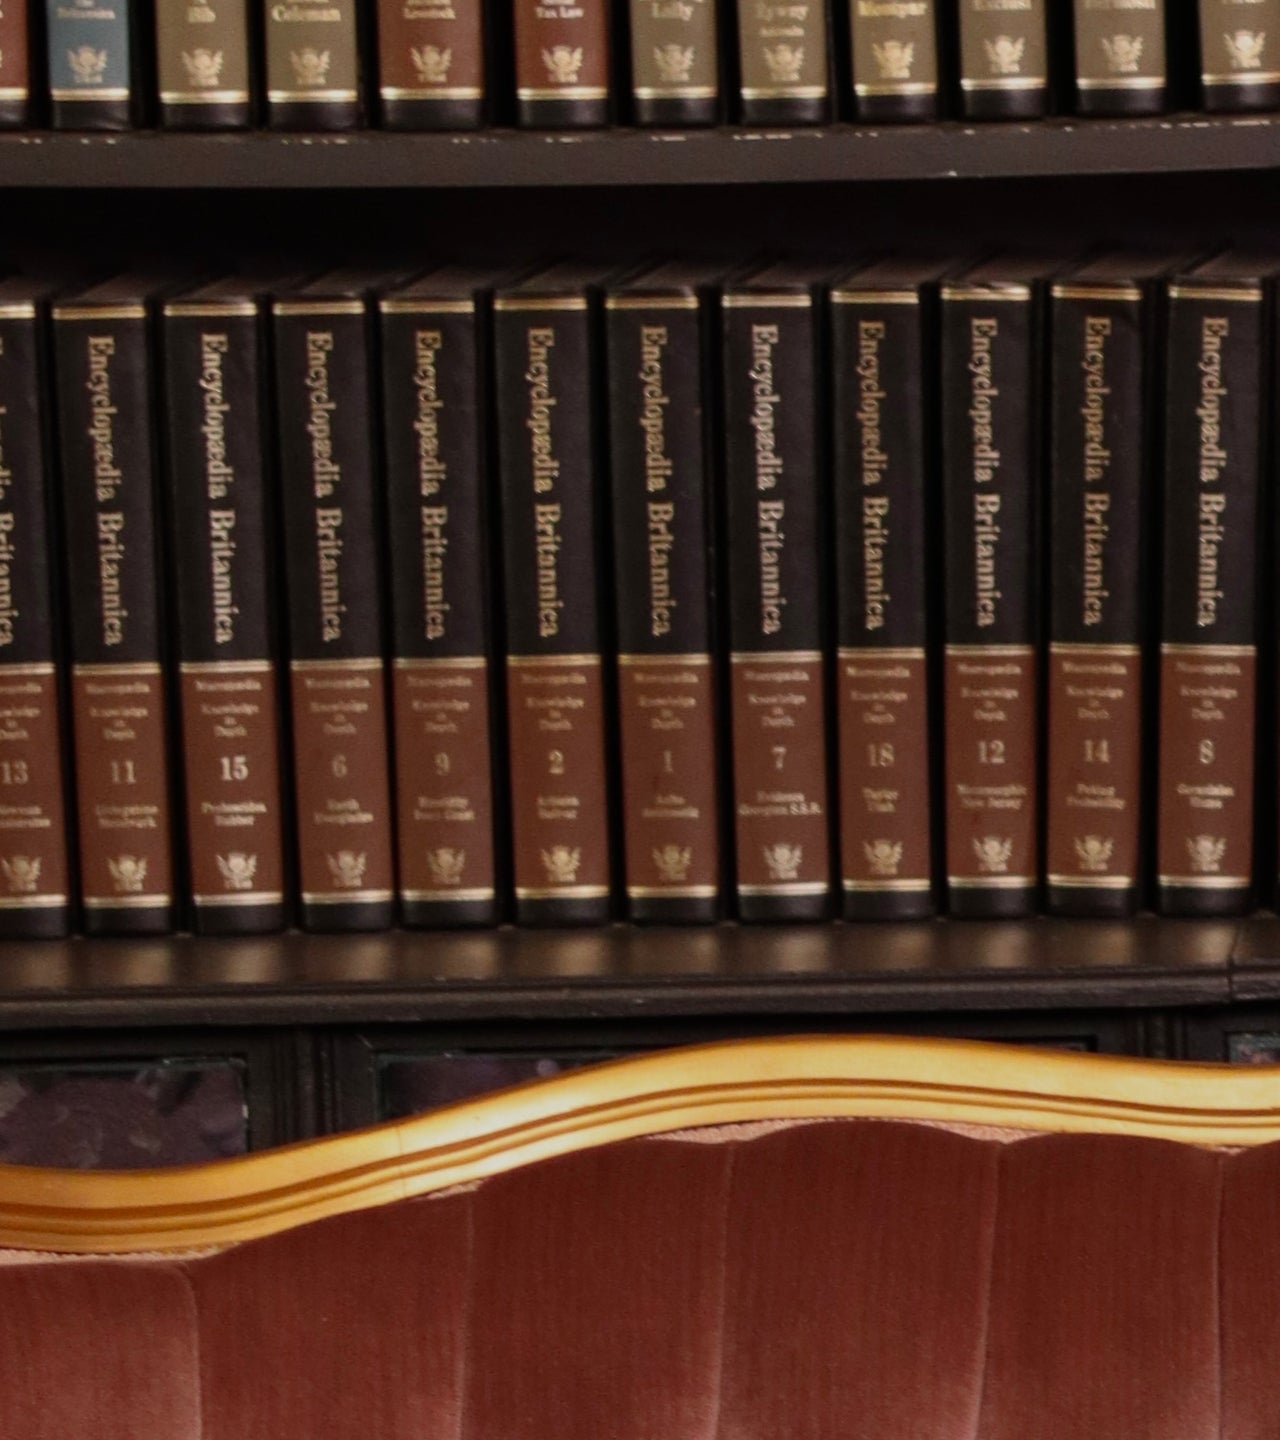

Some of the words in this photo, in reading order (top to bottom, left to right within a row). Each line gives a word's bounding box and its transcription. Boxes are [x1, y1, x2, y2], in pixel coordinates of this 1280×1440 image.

[98, 512, 128, 646] Britannica
[209, 510, 239, 644] Britannica
[316, 508, 346, 642] Britannica
[421, 506, 450, 640] Britannica
[535, 503, 564, 638] Britannica
[647, 502, 676, 637] Britannica
[758, 500, 787, 635] Britannica
[863, 496, 890, 631] Britannica
[975, 494, 1001, 626] Britannica
[1084, 493, 1110, 626] Britannica
[1197, 493, 1226, 627] Britannica
[2, 759, 29, 784] 13
[110, 759, 136, 785] 11
[219, 755, 249, 782] 15
[331, 753, 348, 778] 6
[434, 751, 451, 777] 9
[548, 748, 565, 775] 2
[771, 745, 788, 772] 7
[977, 739, 1006, 765] 12
[1084, 738, 1110, 764] 14
[1198, 738, 1216, 765] 8
